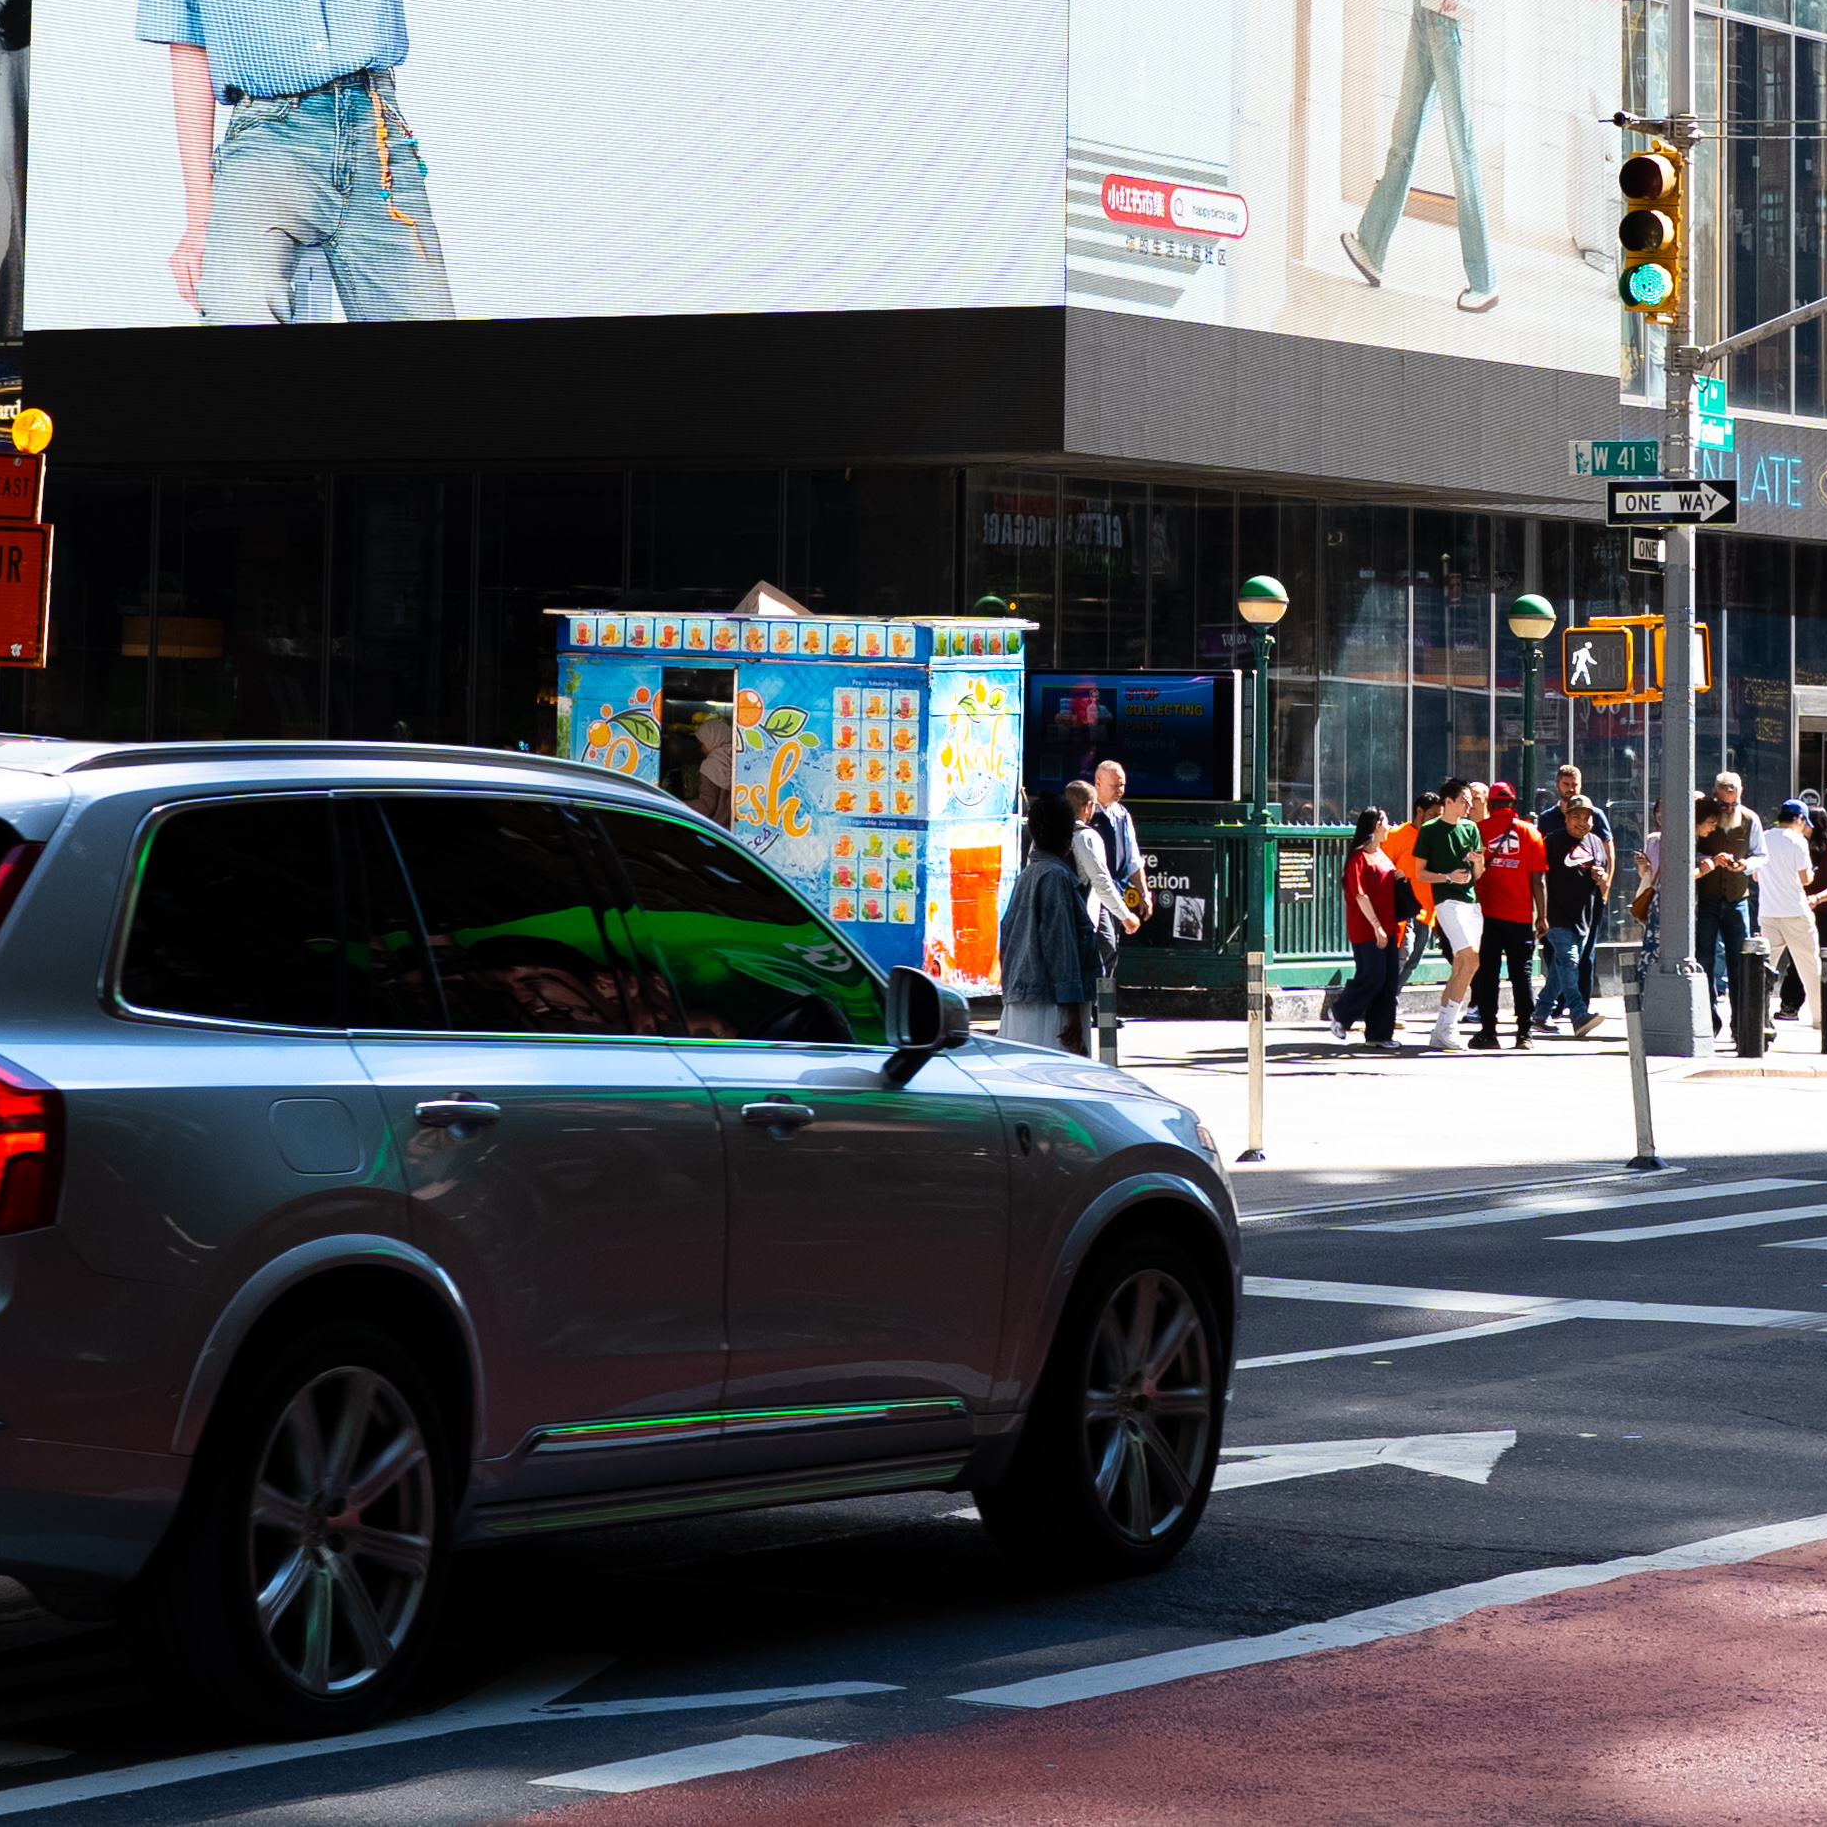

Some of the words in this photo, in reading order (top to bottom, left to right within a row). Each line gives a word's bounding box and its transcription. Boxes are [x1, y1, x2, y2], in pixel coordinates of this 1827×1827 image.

[1107, 183, 1166, 218] 小红书市集
[1593, 447, 1609, 471] W
[1617, 446, 1636, 471] 41
[1643, 446, 1657, 463] St
[1735, 452, 1803, 509] LATE
[1624, 494, 1662, 512] ONE
[1678, 493, 1718, 512] WAY
[1638, 540, 1658, 559] ONE
[1125, 687, 1160, 700] STOP
[1125, 704, 1204, 716] COLLECTING
[1125, 719, 1161, 732] PAINT
[1146, 875, 1190, 890] ation
